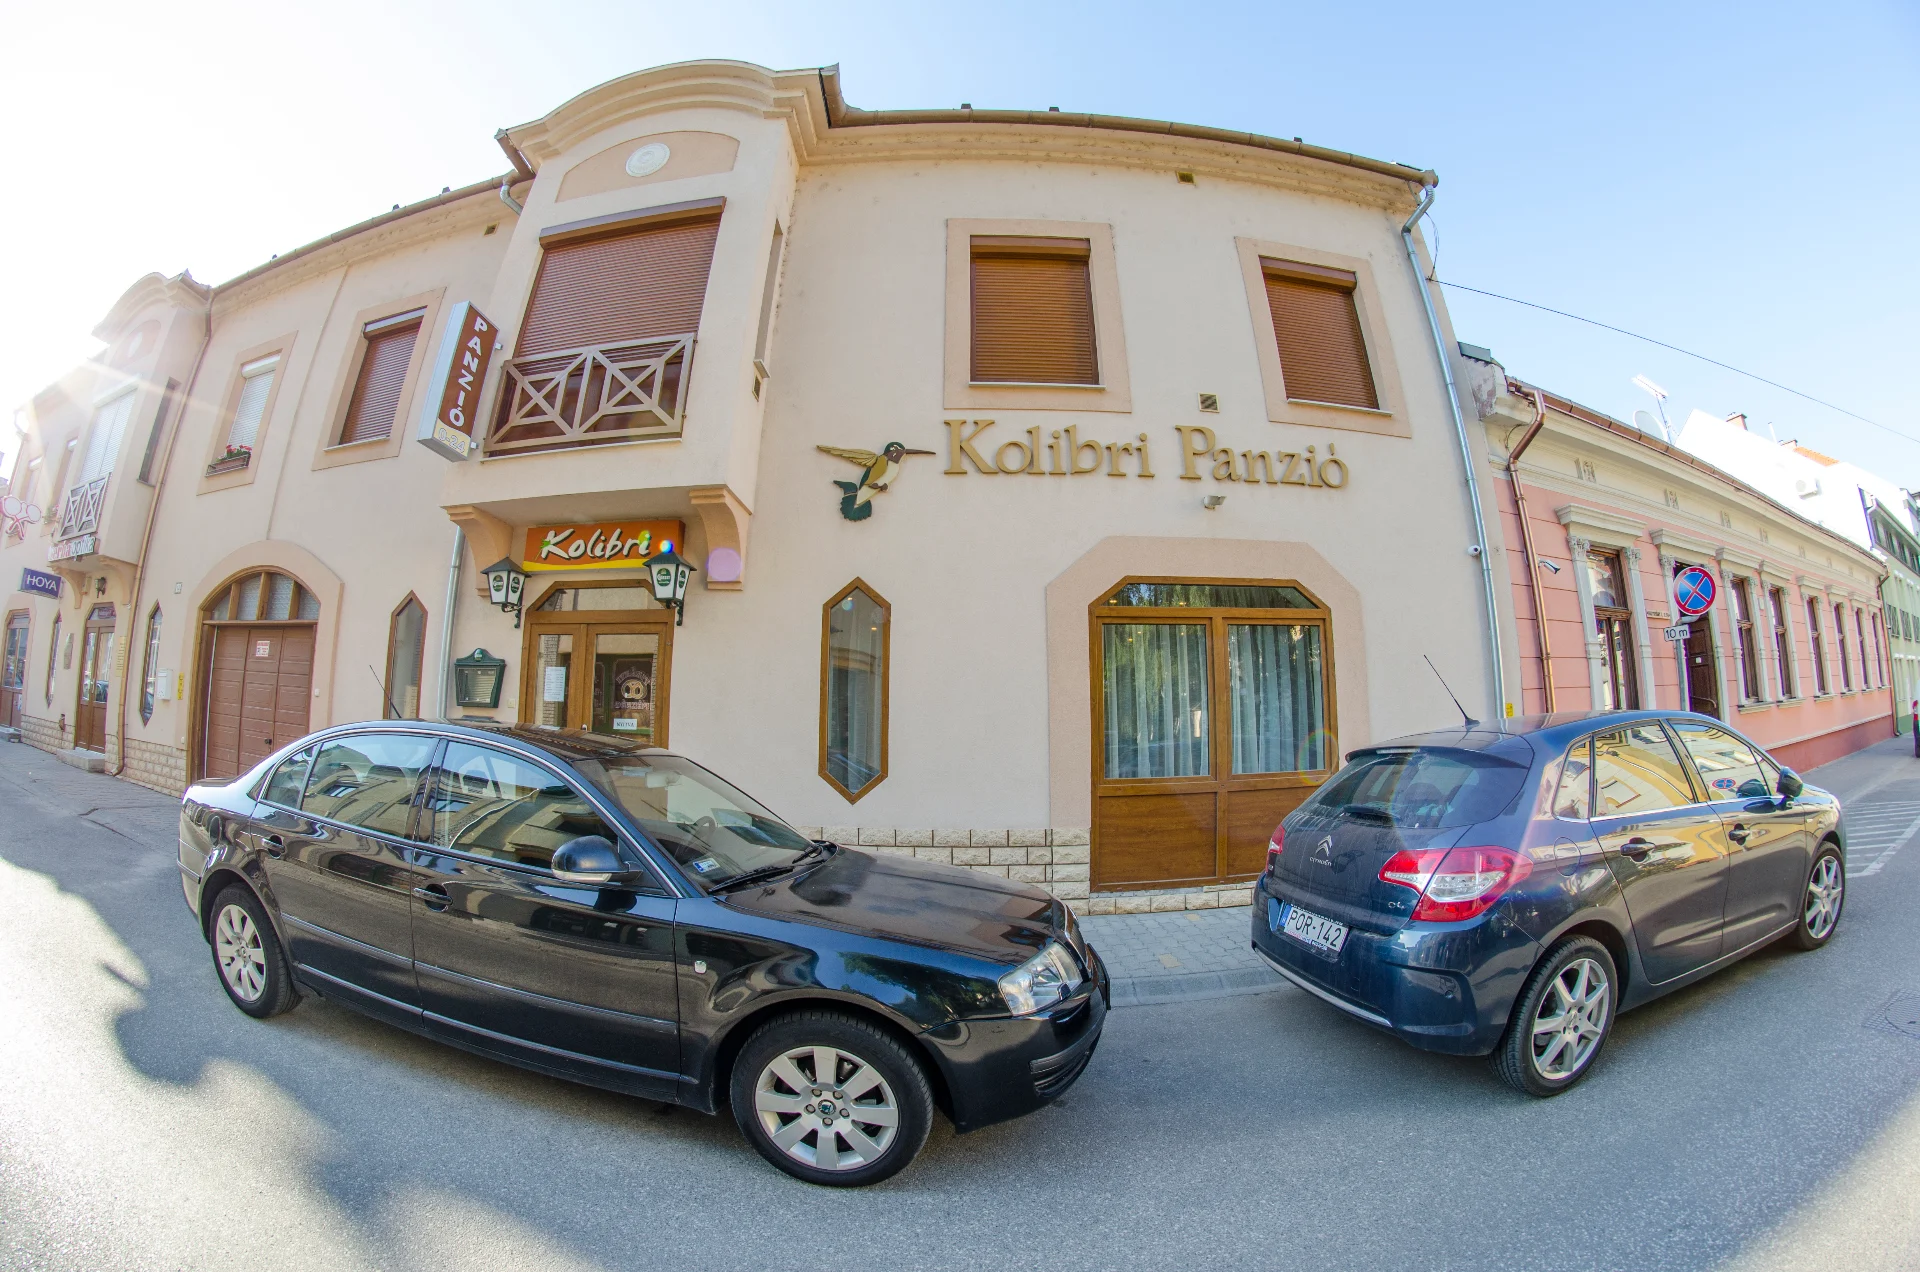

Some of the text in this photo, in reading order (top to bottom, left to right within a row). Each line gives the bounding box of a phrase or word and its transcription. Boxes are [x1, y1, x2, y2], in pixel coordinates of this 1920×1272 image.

[449, 316, 488, 427] PANZIÓ
[438, 427, 466, 454] 0-24
[943, 419, 1156, 478] Kolibri
[541, 528, 653, 561] Kolibri
[26, 574, 57, 591] HOYA
[1665, 628, 1688, 639] 10 m
[1287, 910, 1342, 947] POR-142
